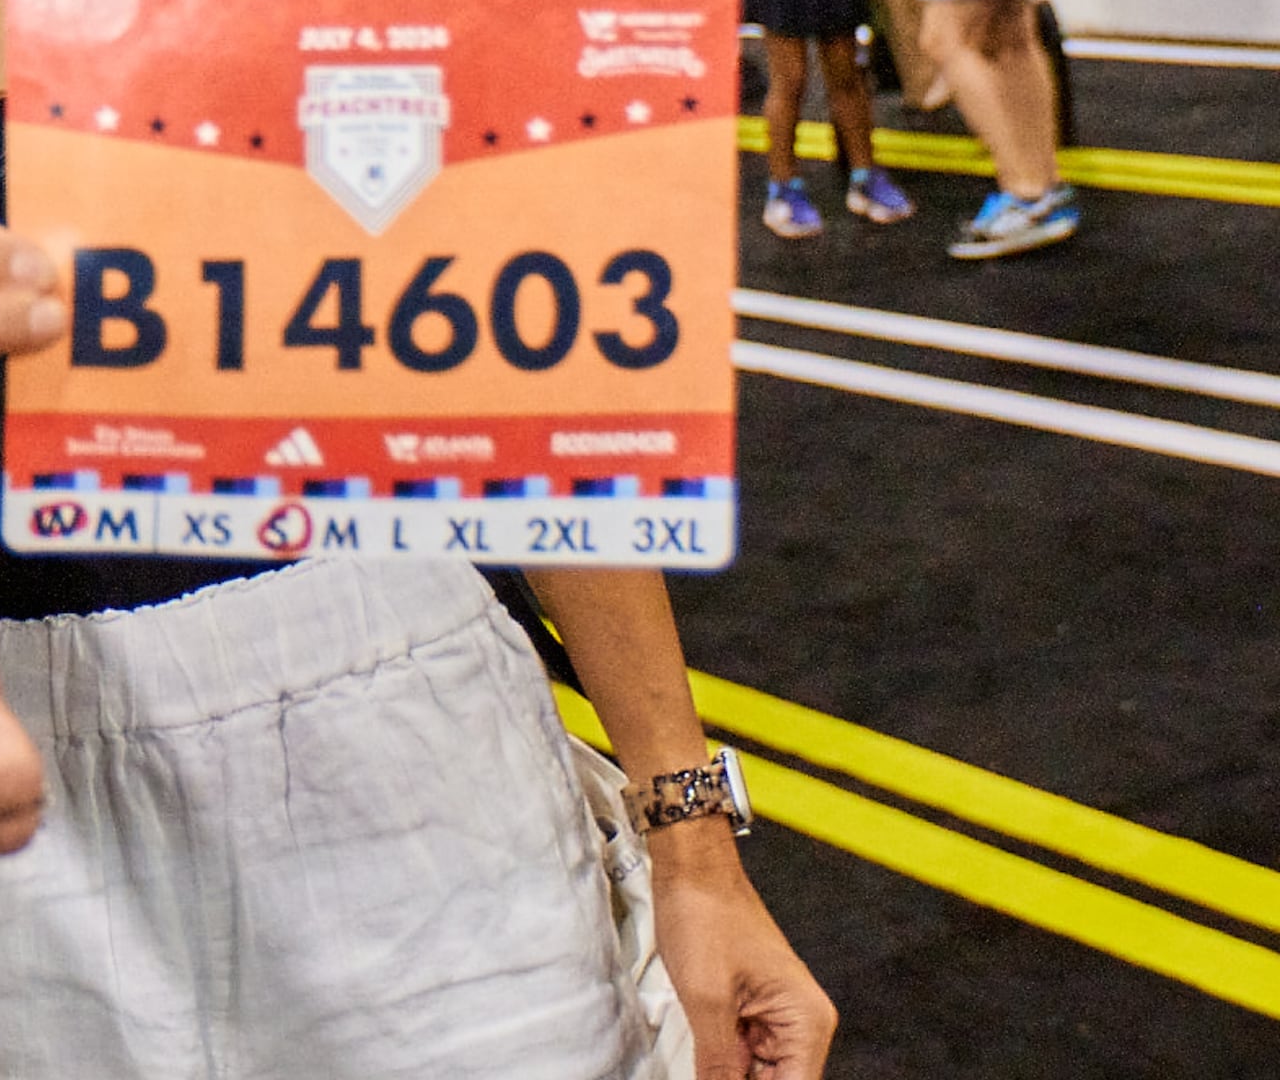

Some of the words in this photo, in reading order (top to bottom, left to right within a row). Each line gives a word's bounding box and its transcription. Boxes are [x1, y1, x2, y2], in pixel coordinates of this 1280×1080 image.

[71, 247, 680, 373] B14603
[96, 508, 139, 542] M
[180, 512, 233, 545] XS
[264, 513, 291, 550] S
[322, 516, 359, 551] M
[393, 517, 409, 551] L
[445, 517, 490, 552] XL
[526, 516, 596, 553] 2XL
[631, 516, 704, 553] 3XL
